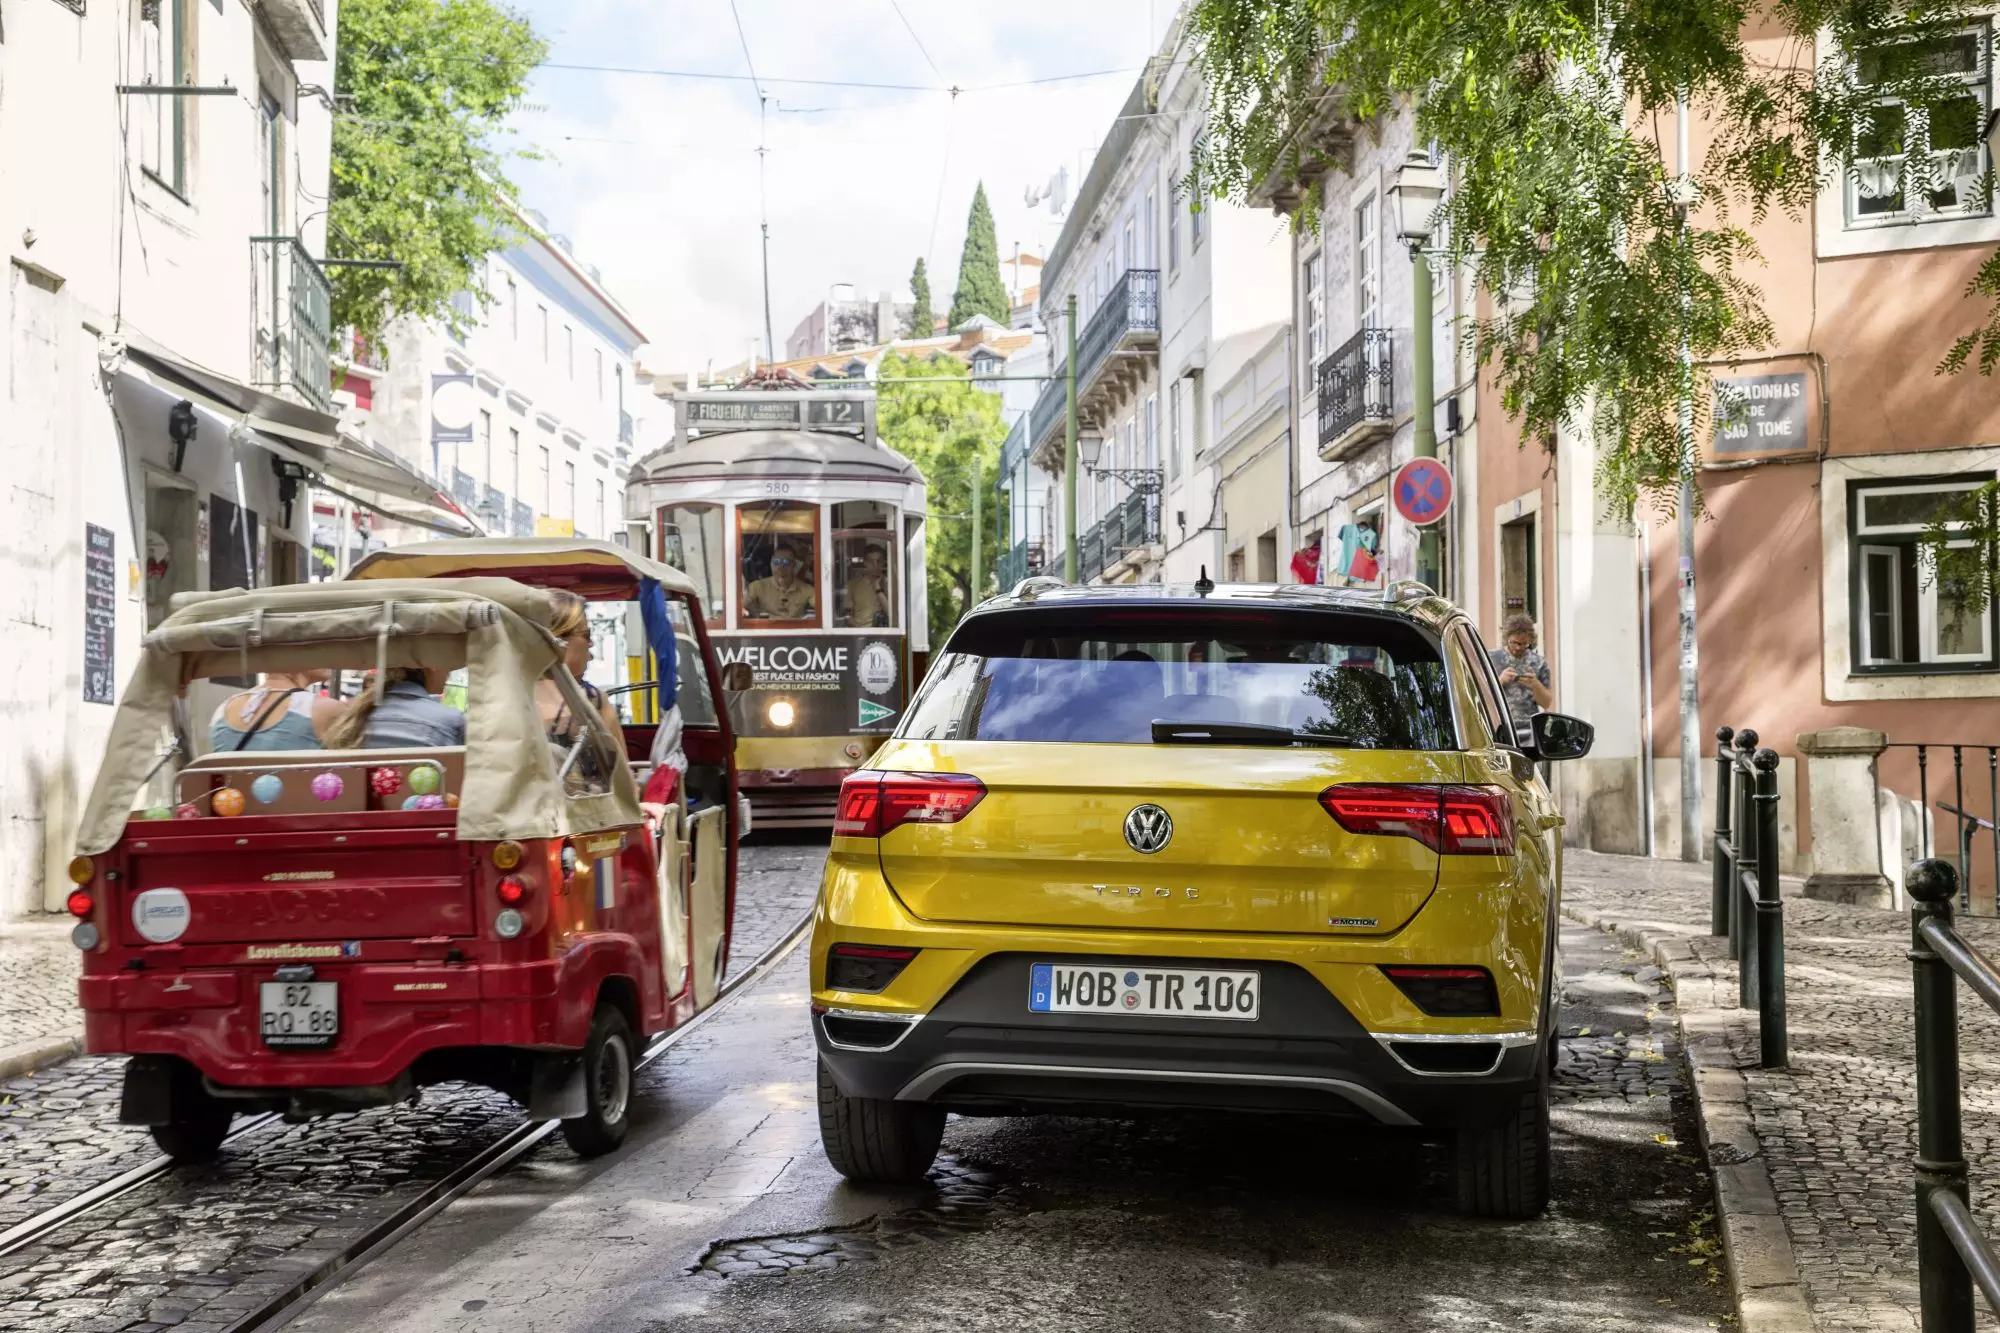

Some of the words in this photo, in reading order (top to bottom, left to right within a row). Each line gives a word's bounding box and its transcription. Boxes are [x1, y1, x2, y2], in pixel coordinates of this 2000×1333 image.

[700, 403, 748, 419] FIGUEIRA
[823, 402, 852, 422] 12
[1750, 405, 1766, 417] DE
[1756, 417, 1793, 437] TOMÉ
[765, 482, 790, 494] 580
[715, 646, 848, 671] WELCOME
[769, 672, 794, 681] PLACE
[795, 672, 805, 681] IN
[805, 672, 840, 681] FASHION
[791, 683, 812, 691] LUGAR
[812, 683, 821, 691] DA
[821, 683, 841, 691] MODA
[1091, 884, 1200, 899] T-ROC
[284, 985, 312, 1008] 62
[1036, 992, 1045, 1004] D
[1055, 970, 1117, 1008] WOB
[1144, 973, 1185, 1010] TR
[1193, 975, 1255, 1013] 106
